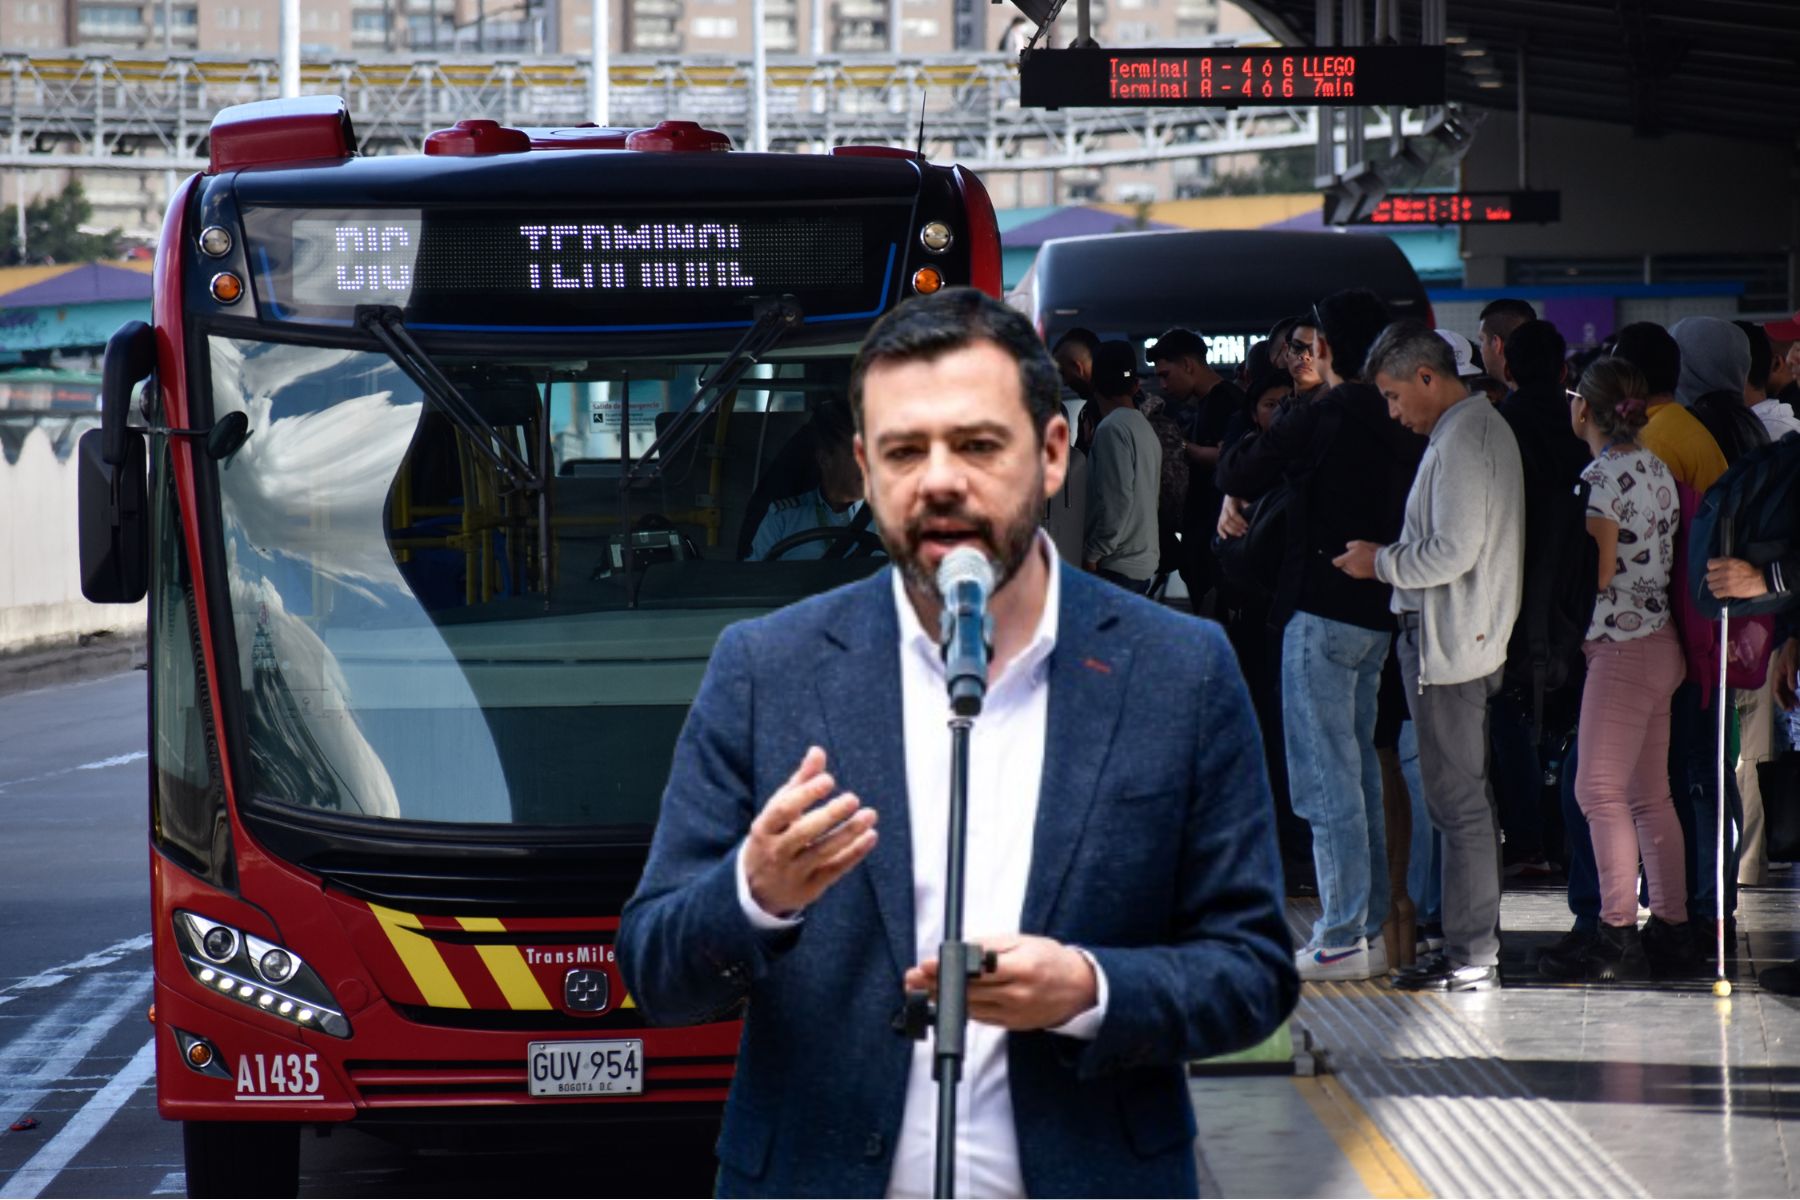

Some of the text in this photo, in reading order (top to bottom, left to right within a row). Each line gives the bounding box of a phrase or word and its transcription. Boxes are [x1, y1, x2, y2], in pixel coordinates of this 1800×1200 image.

[1110, 57, 1188, 78] Terminal
[1201, 57, 1213, 78] A
[1241, 57, 1253, 78] 4
[1282, 57, 1294, 78] 6
[1302, 56, 1356, 78] LLEGO
[1110, 78, 1188, 98] Terminal
[1200, 78, 1213, 98] A
[1241, 78, 1253, 98] 4
[1281, 78, 1294, 98] 6
[1313, 77, 1355, 98] 7min
[519, 223, 755, 290] TERMINAL
[526, 945, 615, 964] TransMile
[237, 1053, 320, 1093] A1435
[533, 1050, 639, 1081] GUV 954
